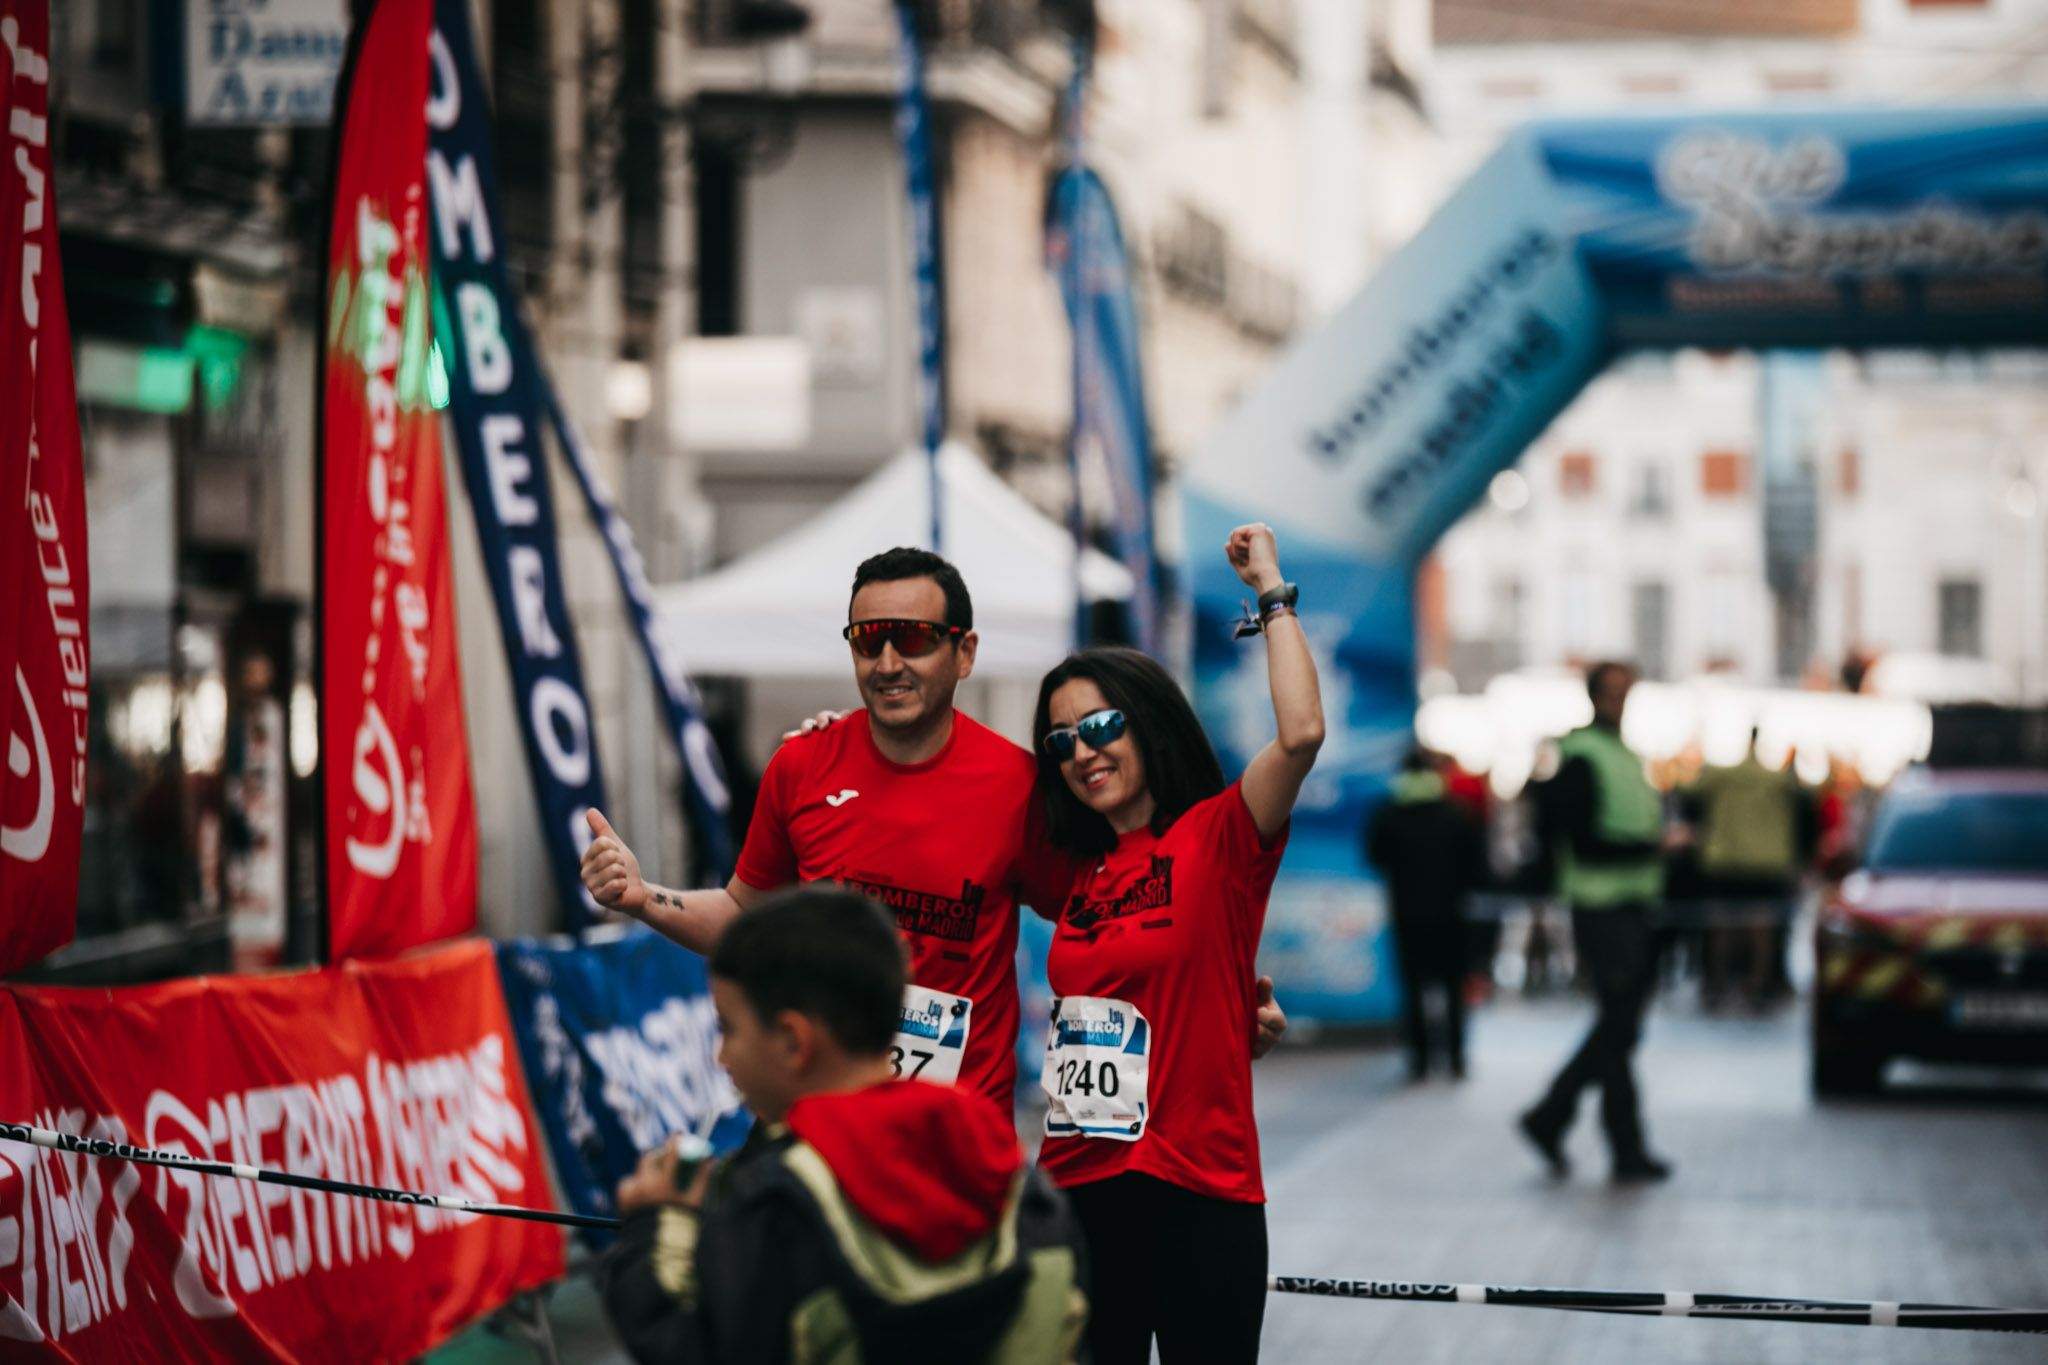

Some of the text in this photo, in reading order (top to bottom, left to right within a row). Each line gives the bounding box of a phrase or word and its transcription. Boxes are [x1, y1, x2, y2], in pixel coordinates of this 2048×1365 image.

[29, 490, 89, 807] science
[901, 1007, 939, 1026] EROS
[1057, 1059, 1120, 1098] 1240
